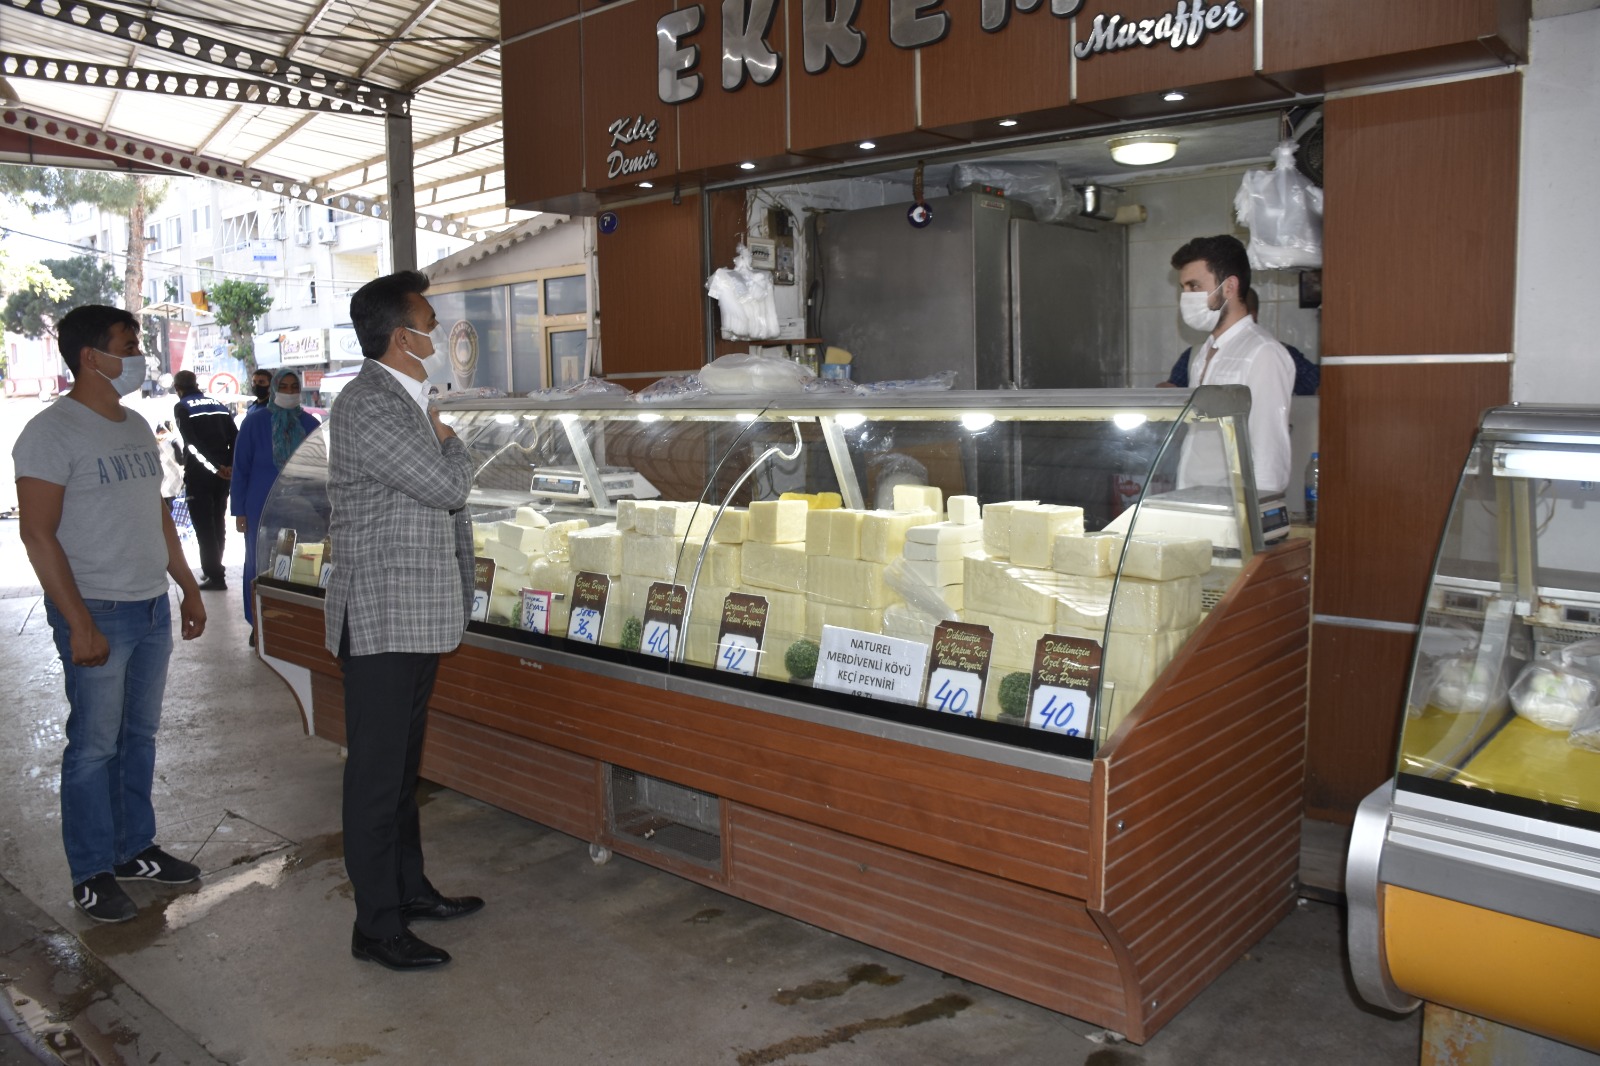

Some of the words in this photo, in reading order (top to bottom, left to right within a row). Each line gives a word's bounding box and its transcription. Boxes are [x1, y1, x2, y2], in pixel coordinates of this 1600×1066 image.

[1074, 0, 1249, 60] Muzaffer
[656, 0, 1083, 105] EKR
[609, 113, 659, 148] Kılıç
[607, 149, 659, 180] Demir
[576, 608, 597, 618] SERT
[649, 600, 663, 612] Tulum
[725, 599, 747, 614] Bergama
[574, 618, 590, 635] 36
[725, 612, 741, 624] Tulum
[742, 615, 762, 628] Peyniri
[648, 626, 670, 653] 40
[946, 628, 981, 645] Dikilimizin
[723, 641, 747, 670] 42
[850, 638, 892, 656] NATUREL
[935, 637, 950, 651] Özel
[973, 646, 988, 661] Keçi
[1045, 641, 1091, 659] Dikilimizin
[827, 651, 883, 671] MERDİVENLİ
[885, 663, 912, 677] KÖYÜ
[938, 654, 957, 667] Tulum
[958, 656, 983, 671] Peyniri
[1042, 651, 1060, 669] Özel
[837, 669, 858, 684] KEÇİ
[859, 673, 895, 691] PEYNİRİ
[1038, 669, 1057, 684] Keçi
[1059, 672, 1090, 687] Peyniri
[934, 679, 968, 713] 40
[1040, 695, 1075, 729] 40
